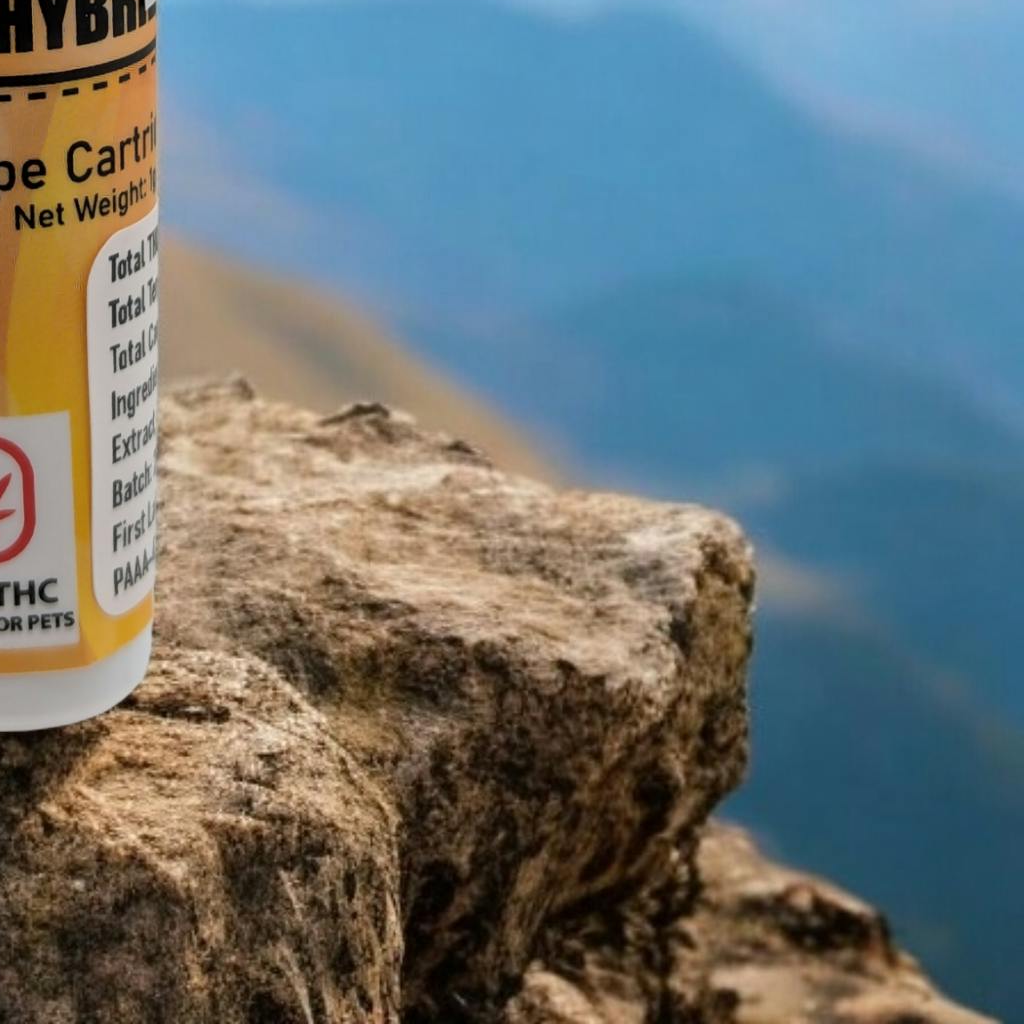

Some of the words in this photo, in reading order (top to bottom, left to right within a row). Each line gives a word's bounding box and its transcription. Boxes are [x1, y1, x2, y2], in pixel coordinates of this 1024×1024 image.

[67, 112, 156, 183] Cartri
[14, 203, 65, 230] Net
[74, 176, 147, 222] Weight:
[108, 239, 145, 282] Total
[108, 285, 145, 328] Total
[109, 329, 145, 373] Total
[112, 509, 145, 552] First
[28, 611, 75, 631] PETS
